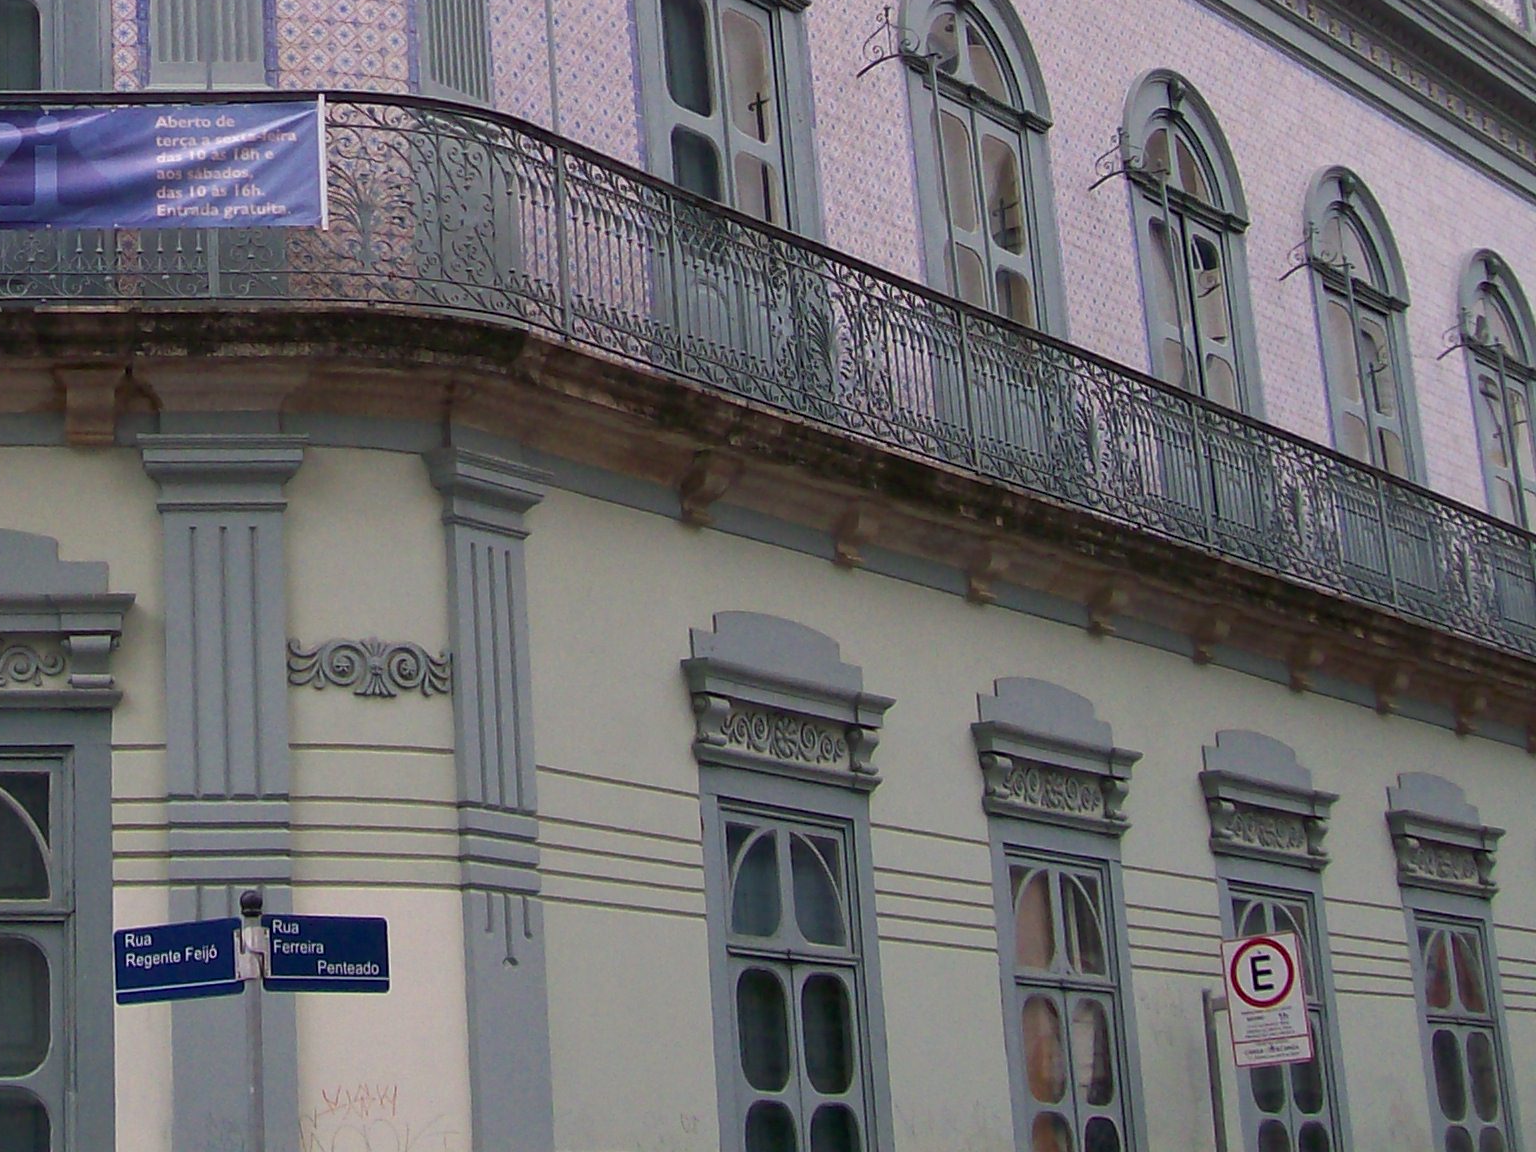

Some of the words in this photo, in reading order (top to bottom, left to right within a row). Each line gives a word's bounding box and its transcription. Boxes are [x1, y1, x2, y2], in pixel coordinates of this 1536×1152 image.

[155, 115, 211, 128] Aberto
[216, 115, 235, 128] de
[156, 134, 197, 148] terça
[202, 136, 211, 147] a
[156, 151, 182, 164] das
[189, 150, 206, 161] 10
[234, 149, 260, 161] 18h
[265, 150, 274, 160] e
[156, 169, 182, 180] aos
[156, 186, 182, 199] das
[189, 186, 207, 198] 10
[235, 184, 265, 198] 16h.
[156, 203, 220, 217] Entrada
[223, 202, 292, 220] gratuita.
[272, 919, 300, 934] Rua
[124, 933, 152, 948] Rua
[273, 939, 325, 955] Ferreira
[125, 951, 181, 969] Regente
[185, 944, 218, 964] Feijó
[317, 959, 380, 976] Penteado
[1250, 954, 1275, 992] E
